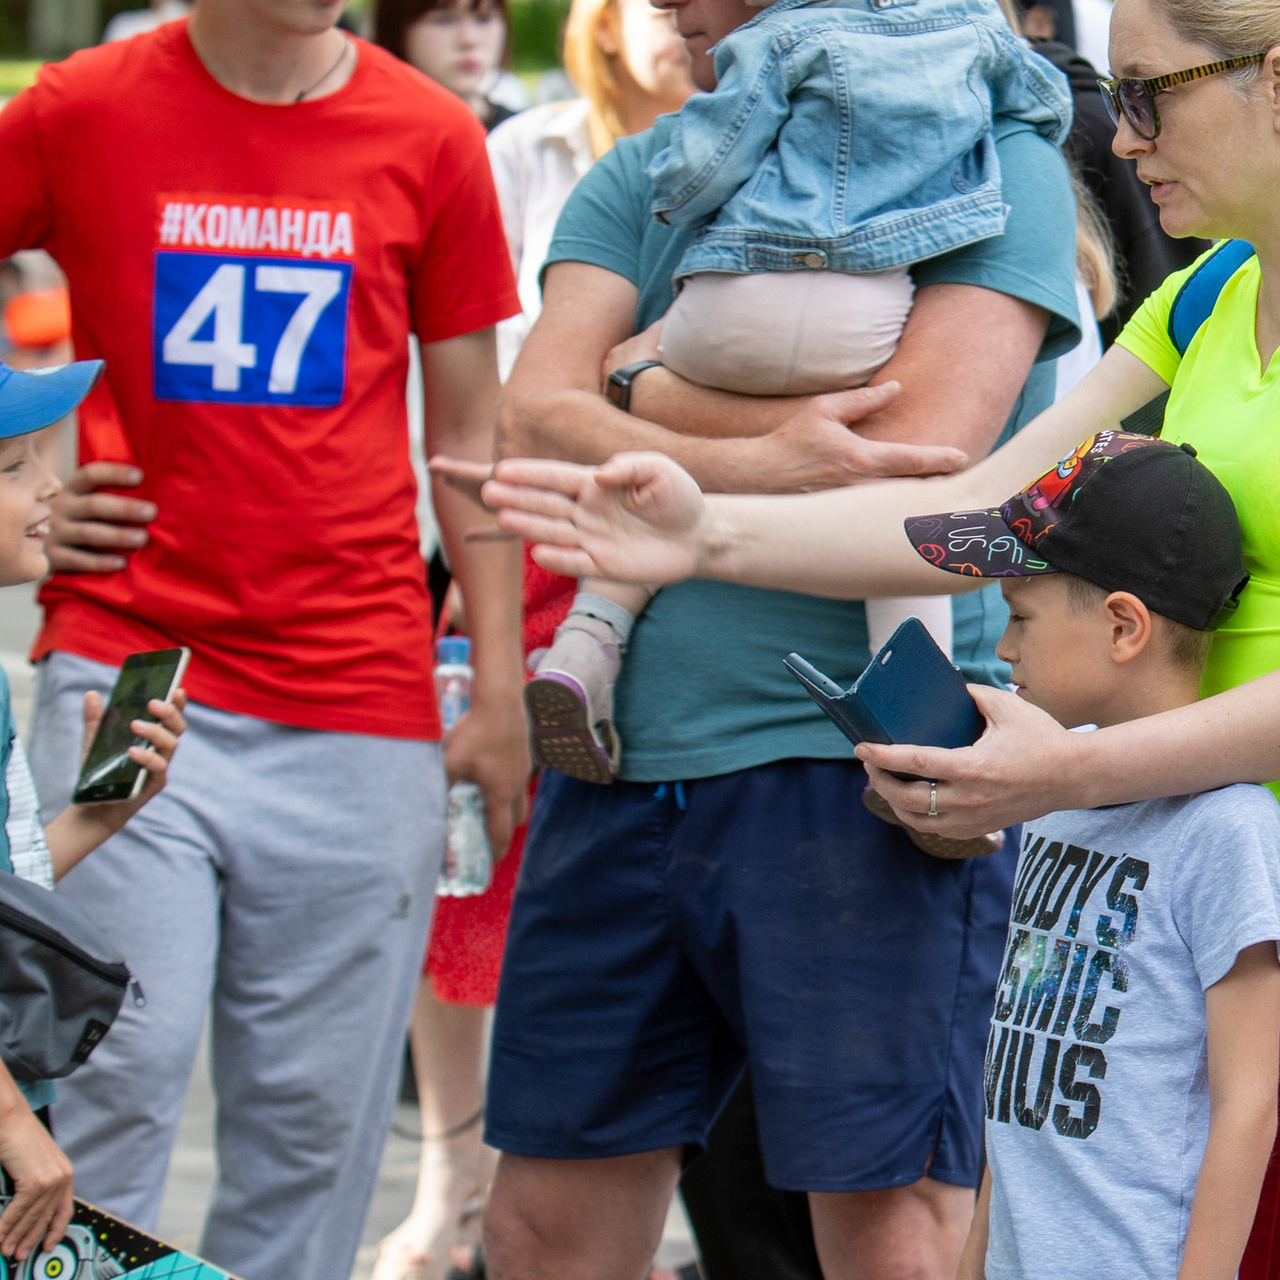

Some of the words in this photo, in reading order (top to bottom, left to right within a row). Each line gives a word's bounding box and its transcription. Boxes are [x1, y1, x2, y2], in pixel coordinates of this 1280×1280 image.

[160, 202, 354, 257] #КОМАНДА
[163, 263, 343, 394] 47
[1090, 428, 1116, 454] ATES
[948, 525, 987, 552] US
[995, 926, 1129, 1045] SMIC
